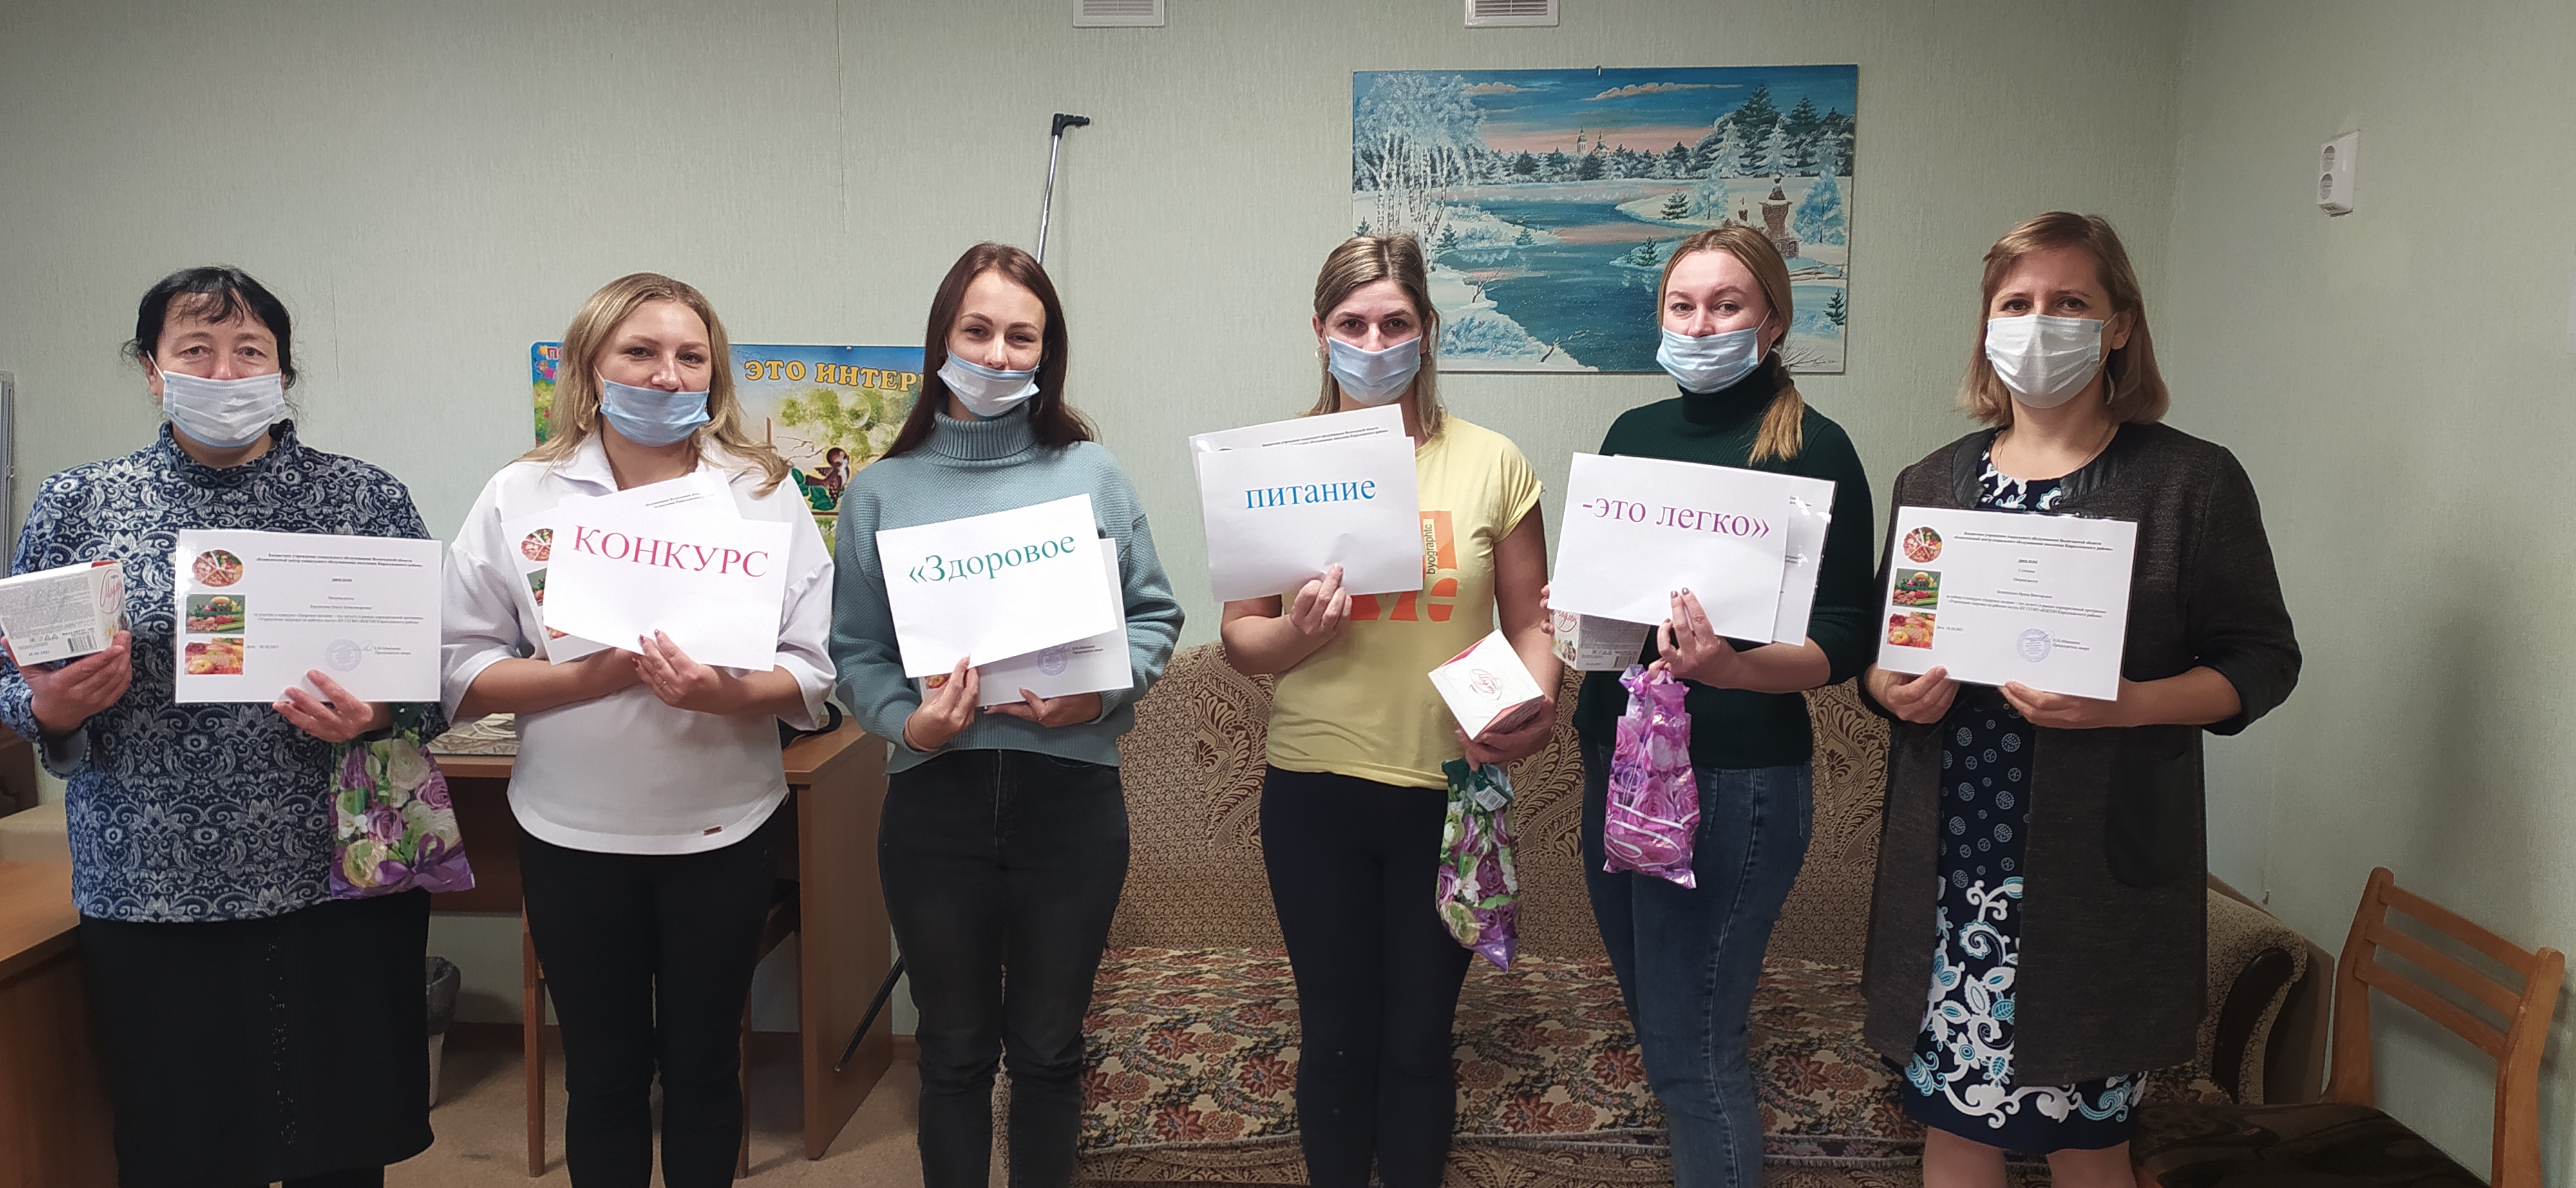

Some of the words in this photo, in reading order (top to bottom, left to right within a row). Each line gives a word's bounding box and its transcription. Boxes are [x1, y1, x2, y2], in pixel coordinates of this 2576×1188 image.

[744, 359, 807, 381] ЭТО
[814, 361, 924, 393] ИНТЕР
[1245, 479, 1377, 510] питание
[1582, 497, 1646, 522] -это
[1656, 504, 1770, 539] легко»
[571, 524, 769, 578] КОНКУРС
[909, 535, 1076, 584] «Здоровое
